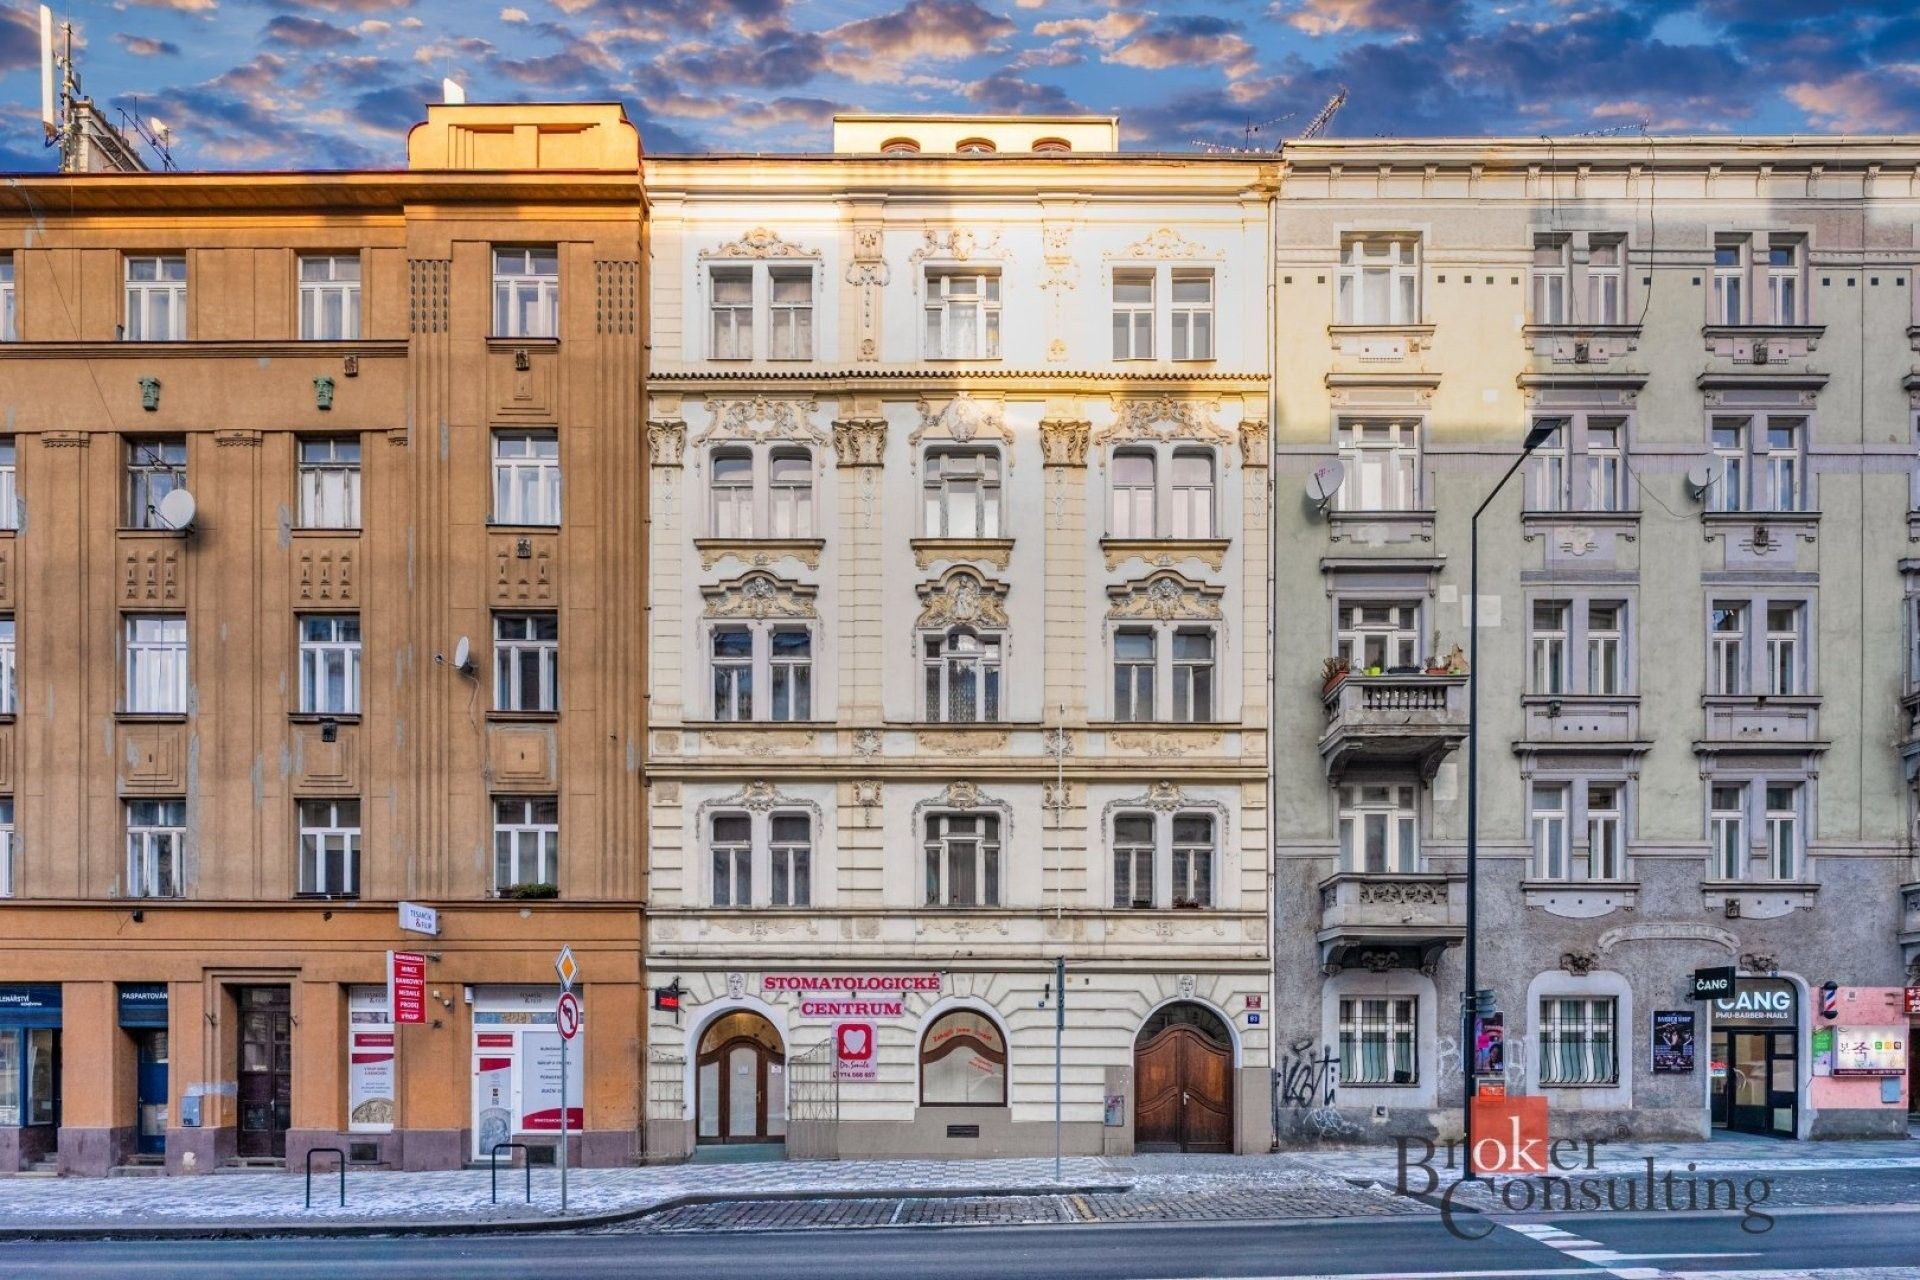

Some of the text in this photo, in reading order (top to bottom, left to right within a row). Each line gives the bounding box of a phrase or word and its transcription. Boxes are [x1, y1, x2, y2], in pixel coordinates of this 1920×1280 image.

[764, 972, 941, 990] STOMATOLOGICKÉ
[1696, 978, 1727, 991] ČANG
[801, 1002, 902, 1016] CENTRUM
